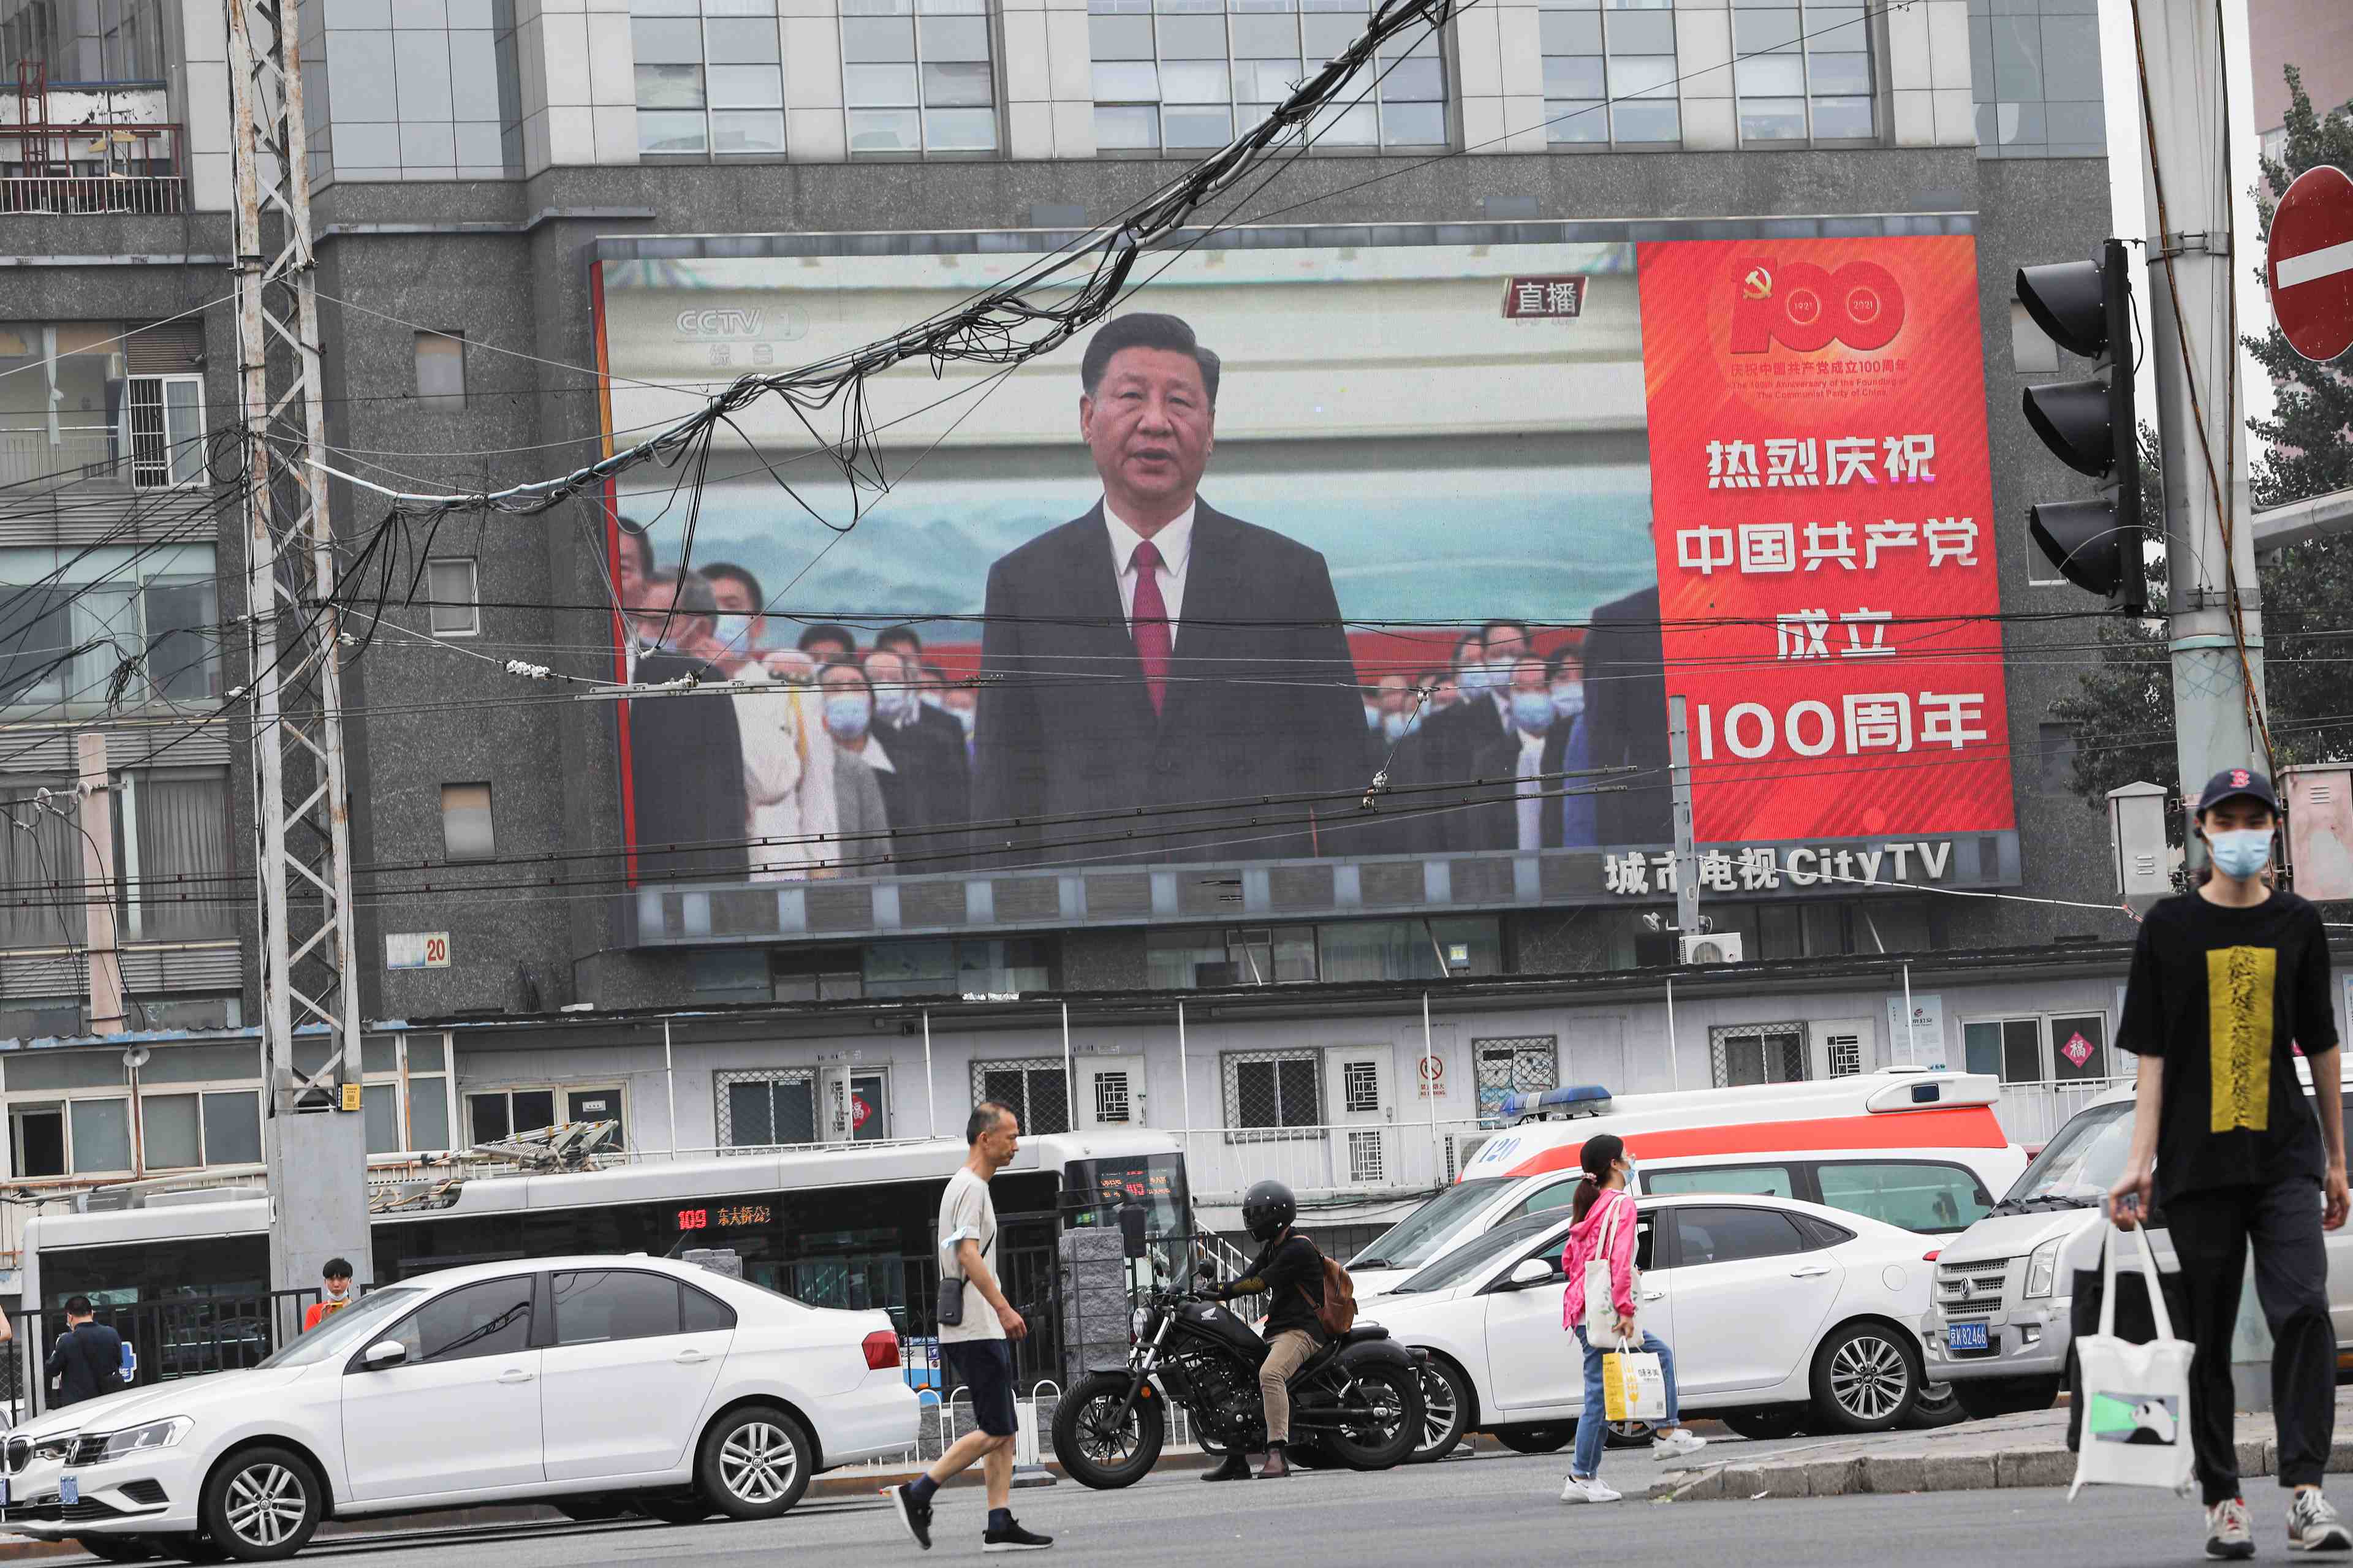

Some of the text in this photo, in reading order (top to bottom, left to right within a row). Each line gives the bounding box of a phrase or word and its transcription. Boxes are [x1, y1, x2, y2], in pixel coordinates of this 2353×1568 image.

[1516, 282, 1577, 314] 直播
[676, 309, 761, 336] CCTV
[1776, 379, 1827, 389] Anniversary
[1857, 377, 1896, 387] Founding
[1826, 390, 1848, 398] Party
[1706, 434, 1936, 488] 热烈庆祝
[1677, 517, 1978, 575] 中国共产党
[1777, 607, 1896, 659] 成立
[1698, 692, 1987, 760] 100周年
[1787, 842, 1950, 886] CityTV
[427, 939, 445, 961] 20
[2070, 1040, 2086, 1058] 福
[1479, 1138, 1521, 1163] 120
[678, 1210, 707, 1230] 109
